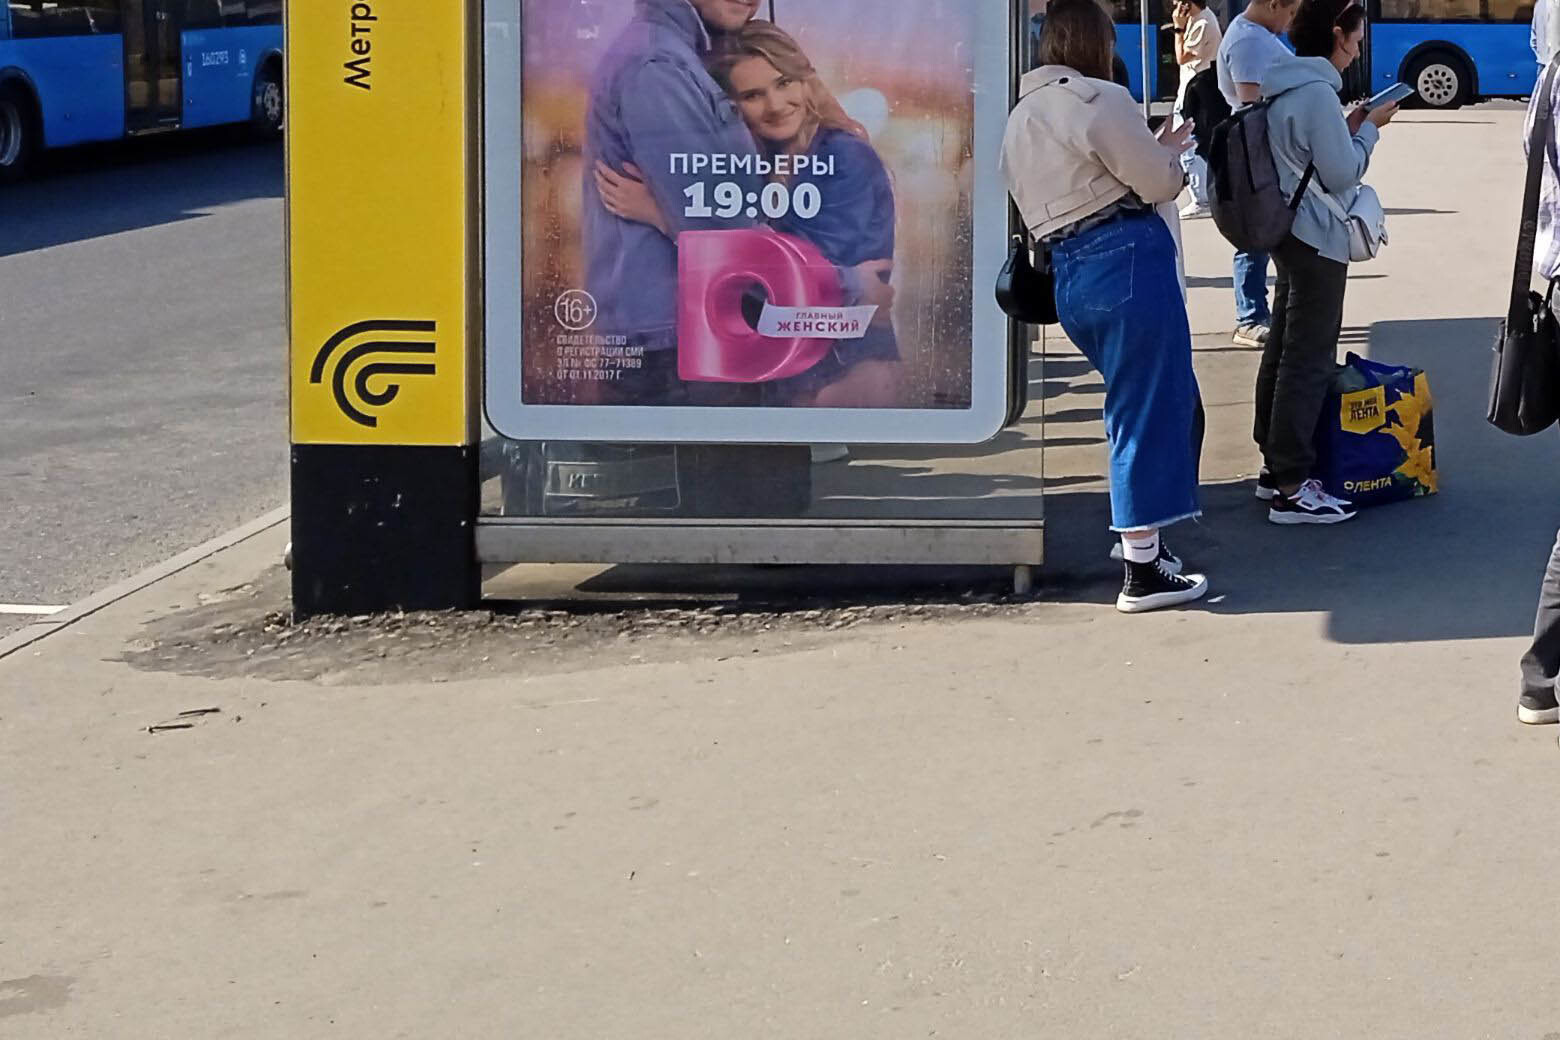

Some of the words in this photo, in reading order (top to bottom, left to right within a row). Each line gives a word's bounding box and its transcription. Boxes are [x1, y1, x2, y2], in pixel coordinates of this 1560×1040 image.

[669, 153, 835, 175] ПРЕМЬЕРЫ
[683, 182, 822, 219] 19:00
[560, 298, 592, 322] 16+
[796, 311, 843, 320] ГЛАВНЫЙ
[777, 320, 860, 333] ЖЕНСКИЙ
[556, 335, 627, 345] СВИДЕТЕЛЬСТВО
[564, 346, 624, 357] РЕГИСТРАЦИИ
[625, 347, 644, 357] СМИ
[1350, 405, 1380, 423] ЛЕНТА
[1354, 476, 1392, 493] ЛЕНТА
